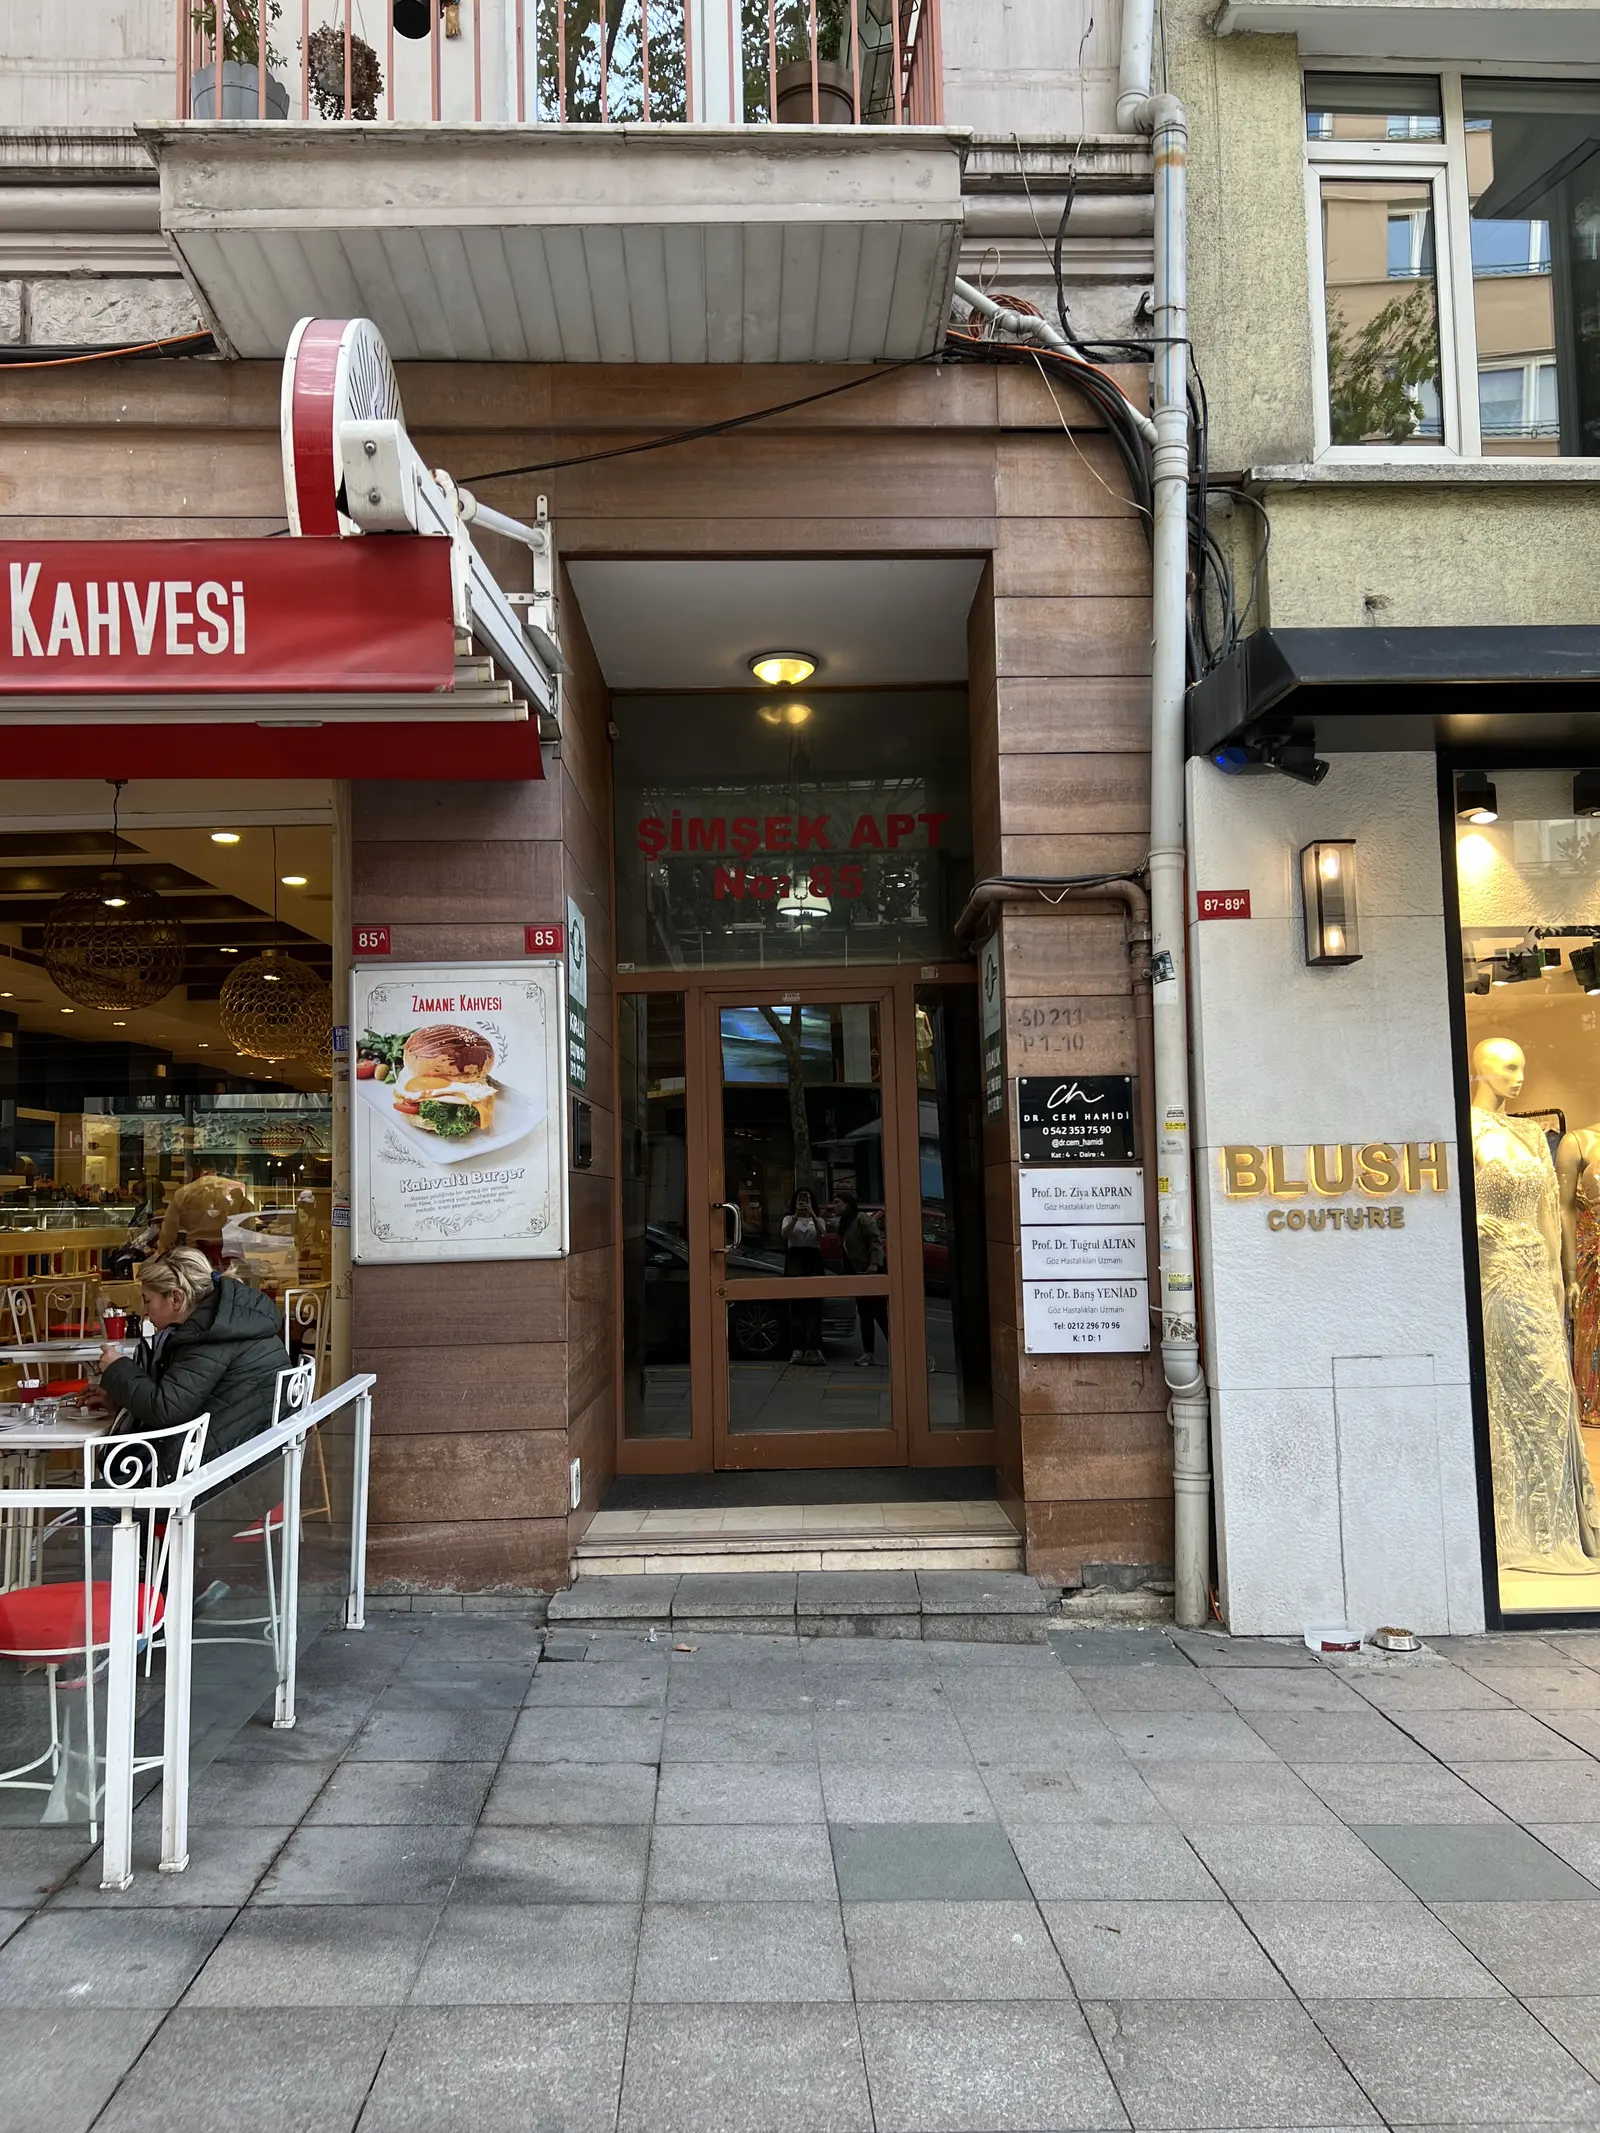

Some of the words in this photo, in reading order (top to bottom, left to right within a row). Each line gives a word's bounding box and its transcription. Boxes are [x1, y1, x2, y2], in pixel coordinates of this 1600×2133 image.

[637, 809, 834, 862] ŞİMŞEK
[850, 813, 949, 848] APT
[808, 865, 864, 899] 85
[358, 932, 386, 947] 85A
[535, 931, 554, 946] 85
[412, 995, 455, 1012] ZAMANE
[1024, 1114, 1044, 1122] DR.
[1052, 1113, 1076, 1121] CEM
[1084, 1111, 1129, 1121] HAMİDİ
[1050, 1127, 1067, 1135] 542
[1069, 1126, 1085, 1135] 353
[1087, 1126, 1099, 1134] 75
[1099, 1125, 1112, 1134] 90
[1222, 1142, 1449, 1196] BLUSH
[400, 1173, 468, 1193] Kahvaltı
[471, 1168, 525, 1184] Burger
[1031, 1187, 1052, 1198] Prof.
[1054, 1187, 1068, 1197] Dr.
[1069, 1187, 1089, 1200] Ziya
[1091, 1186, 1132, 1197] KAPRAN
[1044, 1203, 1058, 1211] Göz
[1095, 1202, 1121, 1210] Uzmanı
[1267, 1206, 1406, 1231] COUTURE
[1031, 1239, 1053, 1250] Prof.
[1054, 1239, 1068, 1250] Dr.
[1070, 1239, 1100, 1252] Tuğrul
[1101, 1238, 1136, 1249] ALTAN
[1046, 1257, 1059, 1265] Göz
[1034, 1288, 1055, 1299] Prof.
[1056, 1288, 1071, 1299] Dr.
[1072, 1288, 1095, 1301] Barış
[1096, 1285, 1138, 1299] YENİAD
[1047, 1306, 1061, 1314] Göz
[1053, 1322, 1066, 1330] Tel:
[1067, 1322, 1085, 1330] 0212
[1086, 1322, 1100, 1330] 296
[1101, 1321, 1110, 1329] 70
[1111, 1321, 1121, 1329] 96
